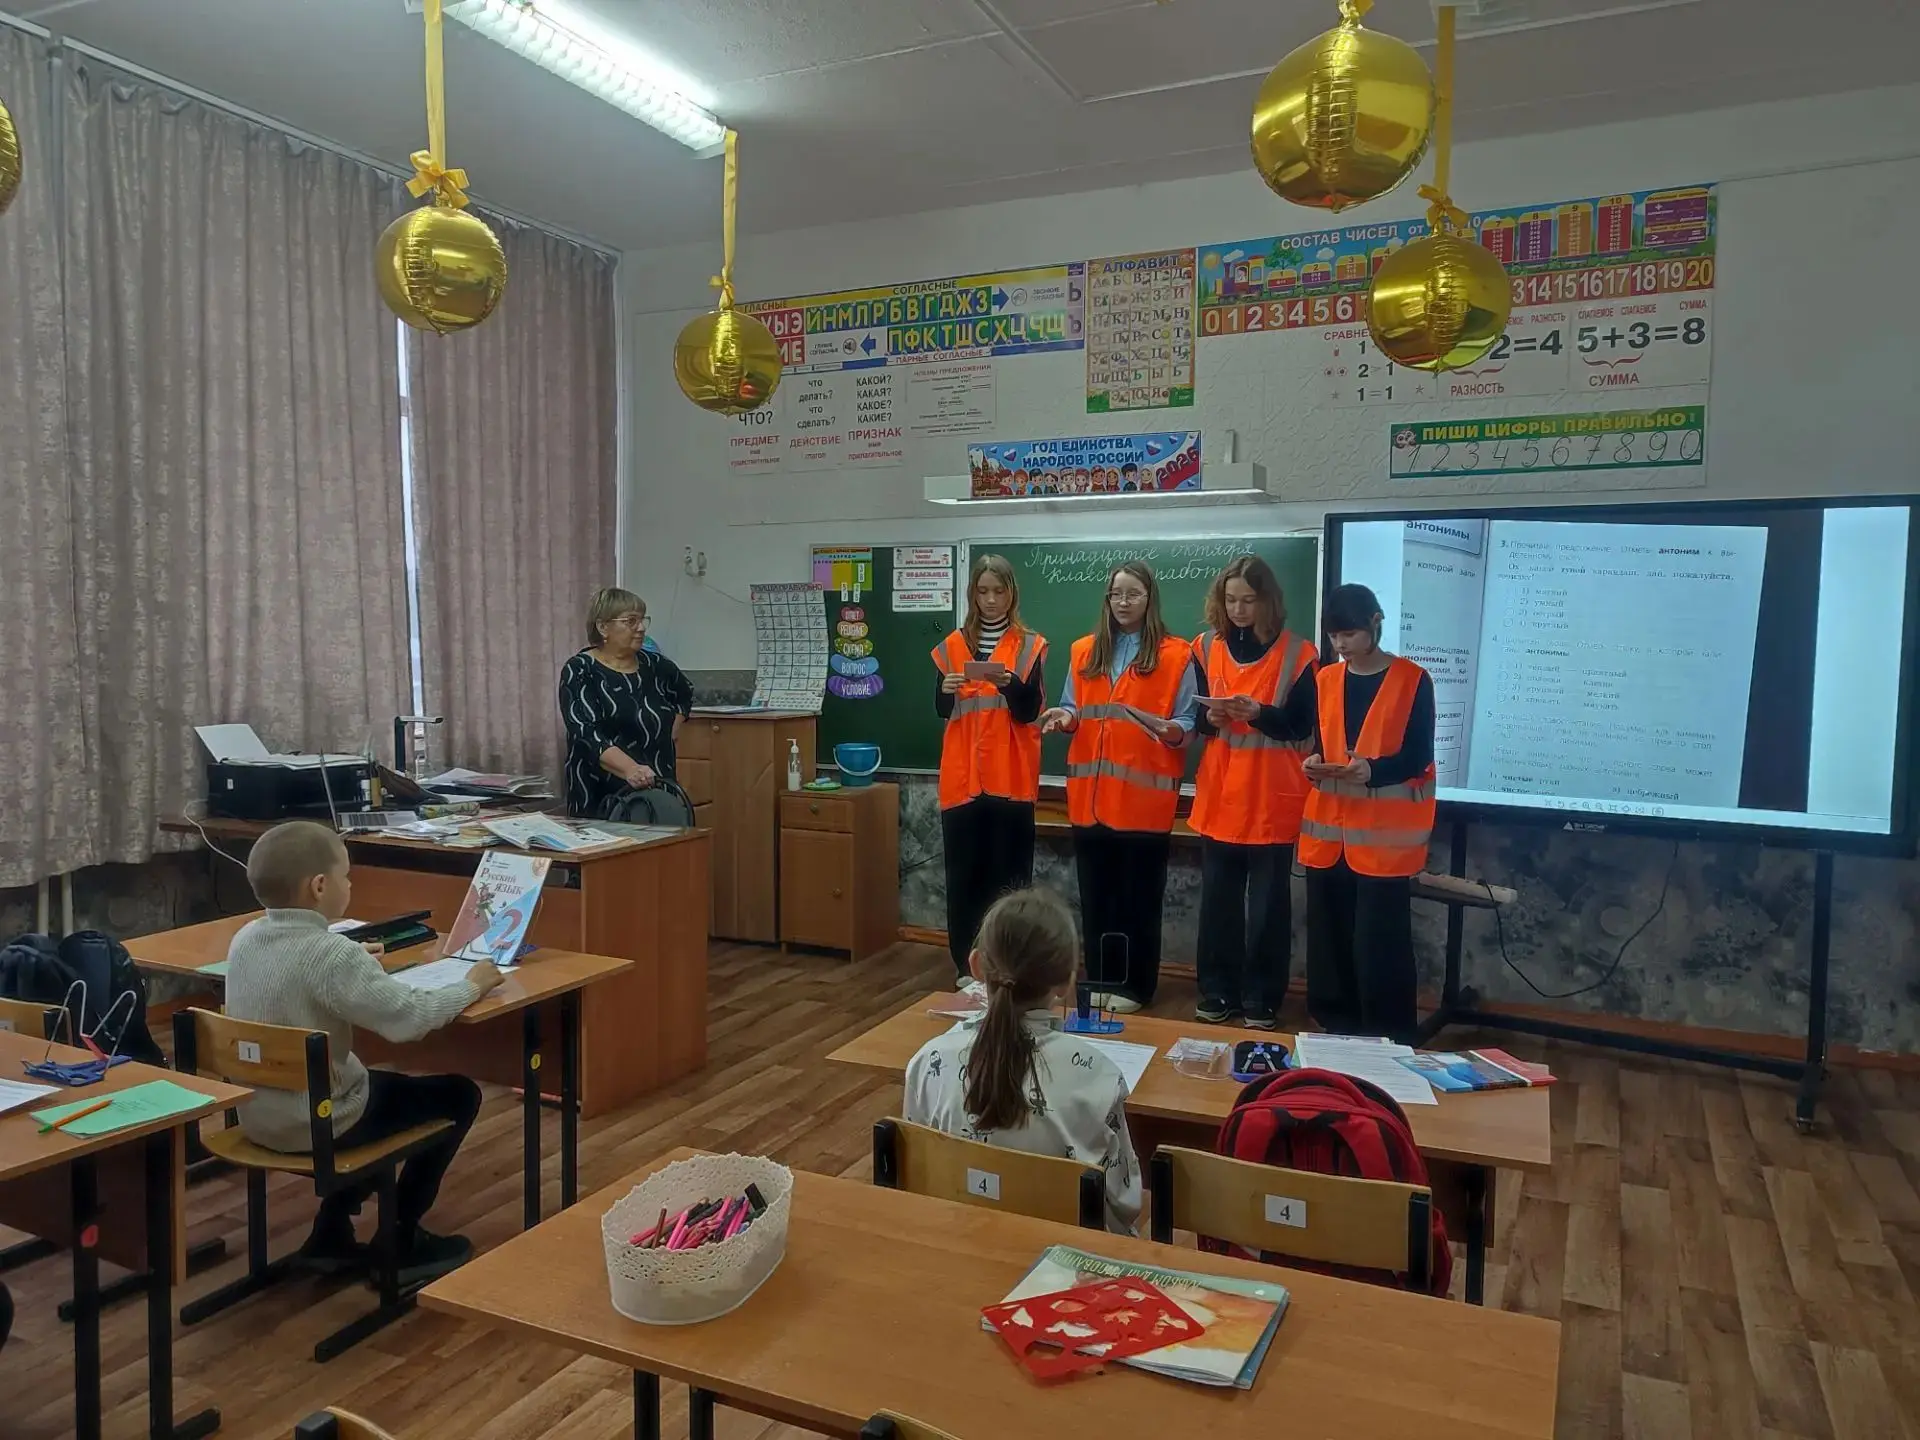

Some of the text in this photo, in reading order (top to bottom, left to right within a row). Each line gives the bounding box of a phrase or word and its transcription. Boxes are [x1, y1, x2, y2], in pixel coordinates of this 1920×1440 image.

[1281, 232, 1340, 250] СОСТАВ
[1345, 225, 1398, 241] ЧИСЕЛ
[1103, 255, 1179, 274] АЛФАВИТ
[892, 280, 957, 295] СОГЛАСНЫЕ
[1205, 259, 1713, 333] 0 1 2 3 4 5 6 3 14 15 16 17 18 19 20
[1679, 299, 1708, 310] СУММА
[1531, 312, 1566, 323] РАЗНОСТЬ
[1174, 327, 1183, 338] Т
[1324, 328, 1372, 341] СРАВНЕ
[896, 349, 984, 364] ПАРНЫЕ СОГЛАСНЫЕ
[856, 374, 892, 386] КАКОЙ?
[1589, 373, 1640, 387] СУММА
[799, 390, 833, 402] делать?
[857, 387, 892, 399] КАКАЯ?
[1451, 382, 1505, 396] РАЗНОСТЬ
[857, 400, 892, 411] КАКОЕ?
[797, 416, 836, 429] сделать?
[857, 412, 892, 424] КАКИЕ?
[848, 427, 902, 441] ПРИЗНАК
[1422, 425, 1479, 440] ПИШИ
[1485, 419, 1557, 438] ЦИФРЫ
[730, 435, 780, 447] ПРЕДМЕТ
[789, 434, 841, 448] ДЕЙСТВИЕ
[1032, 437, 1133, 454] ГОД ЕДИНСТВА
[1408, 429, 1702, 472] 1 2 3 4 5 6 7 8 9 0
[1023, 451, 1145, 468] НАРОДОВ РОССИИ
[1156, 446, 1199, 481] 2026
[1406, 520, 1470, 541] антонимы
[1658, 547, 1700, 556] антоним
[1045, 559, 1222, 584] Классн работ
[1417, 561, 1454, 573] которой
[1526, 648, 1570, 657] антонимы
[841, 662, 866, 675] ВОПРОС
[480, 867, 516, 883] Русский
[490, 908, 523, 950] 2
[978, 1177, 989, 1193] 4
[1280, 1204, 1291, 1220] 4
